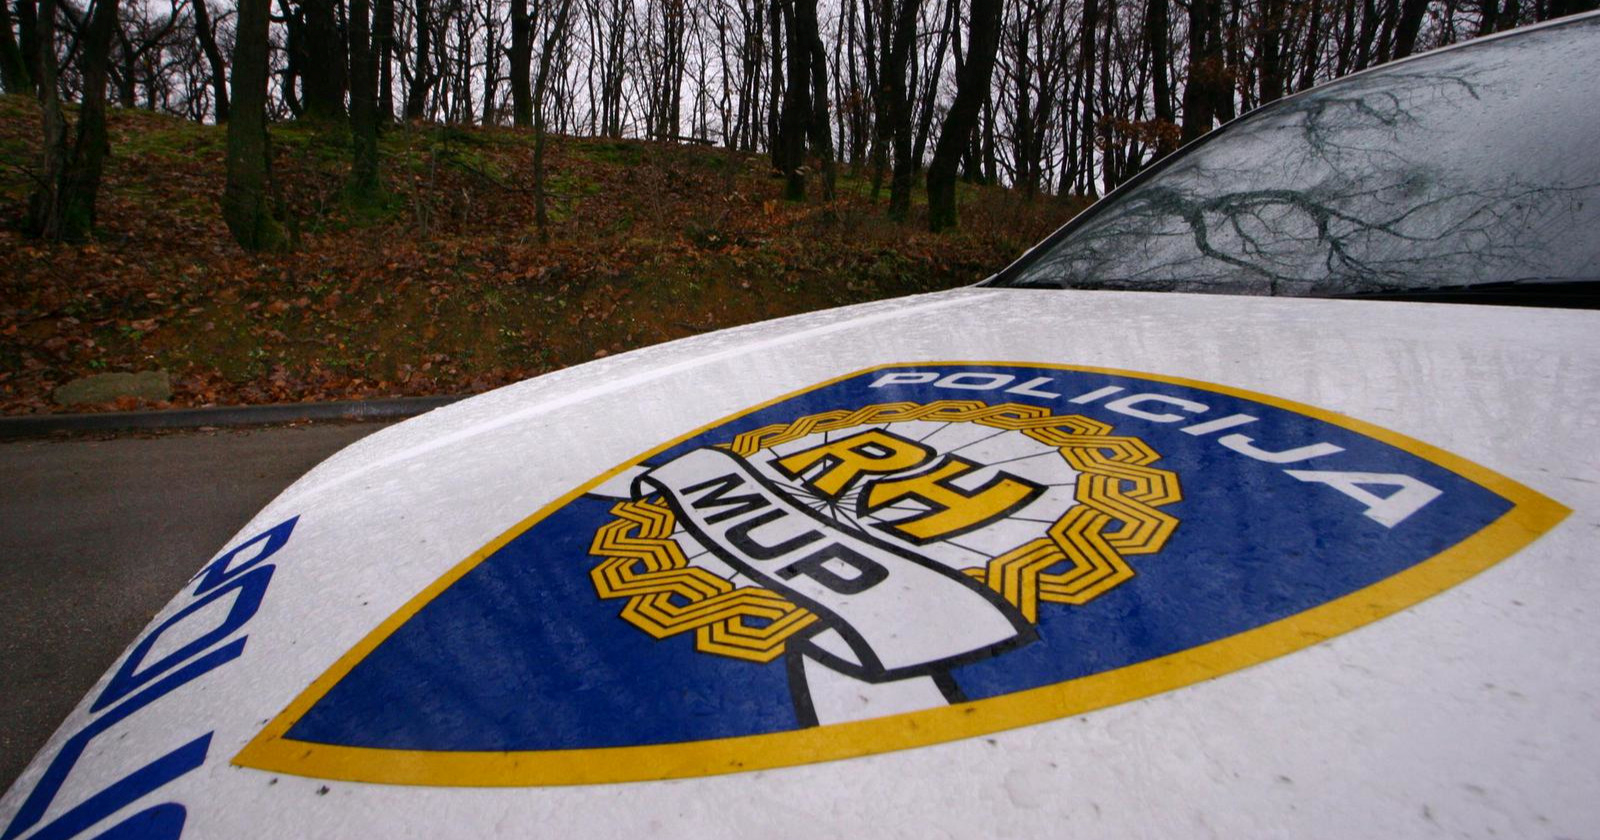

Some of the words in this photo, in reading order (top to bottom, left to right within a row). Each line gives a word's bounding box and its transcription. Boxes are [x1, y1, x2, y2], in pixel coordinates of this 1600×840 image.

[766, 428, 1049, 546] RH
[868, 372, 1443, 529] POLICIJA
[680, 472, 890, 595] MUP
